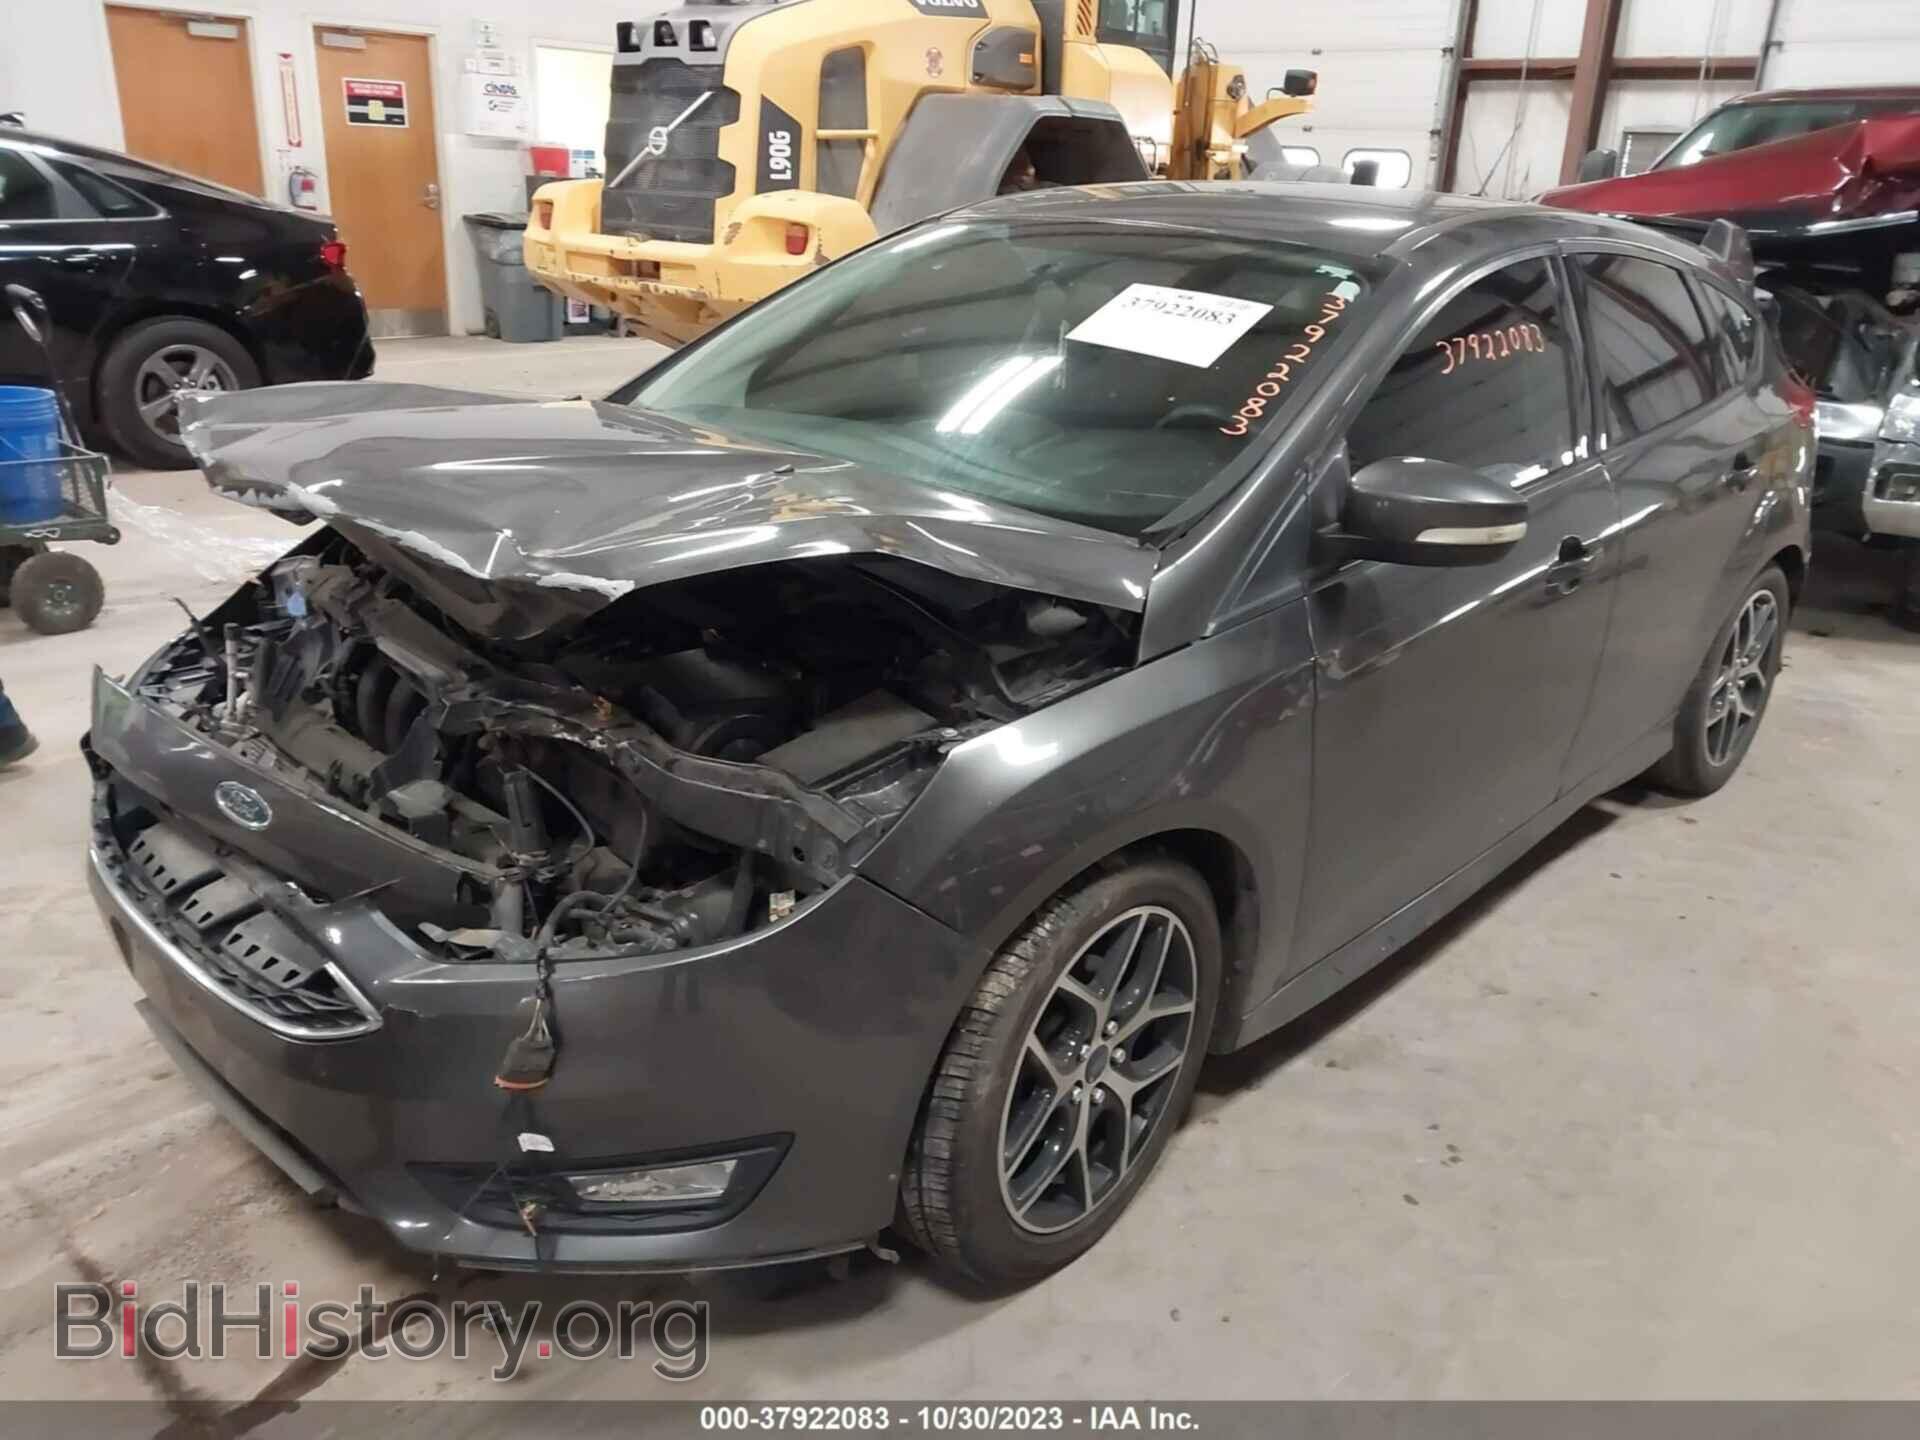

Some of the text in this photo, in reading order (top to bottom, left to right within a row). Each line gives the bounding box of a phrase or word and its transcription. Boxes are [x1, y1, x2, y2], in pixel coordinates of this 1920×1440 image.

[768, 130, 792, 180] L90G
[1121, 296, 1237, 325] 37922083
[1219, 291, 1346, 436] 37922083
[1435, 323, 1544, 374] 37922083
